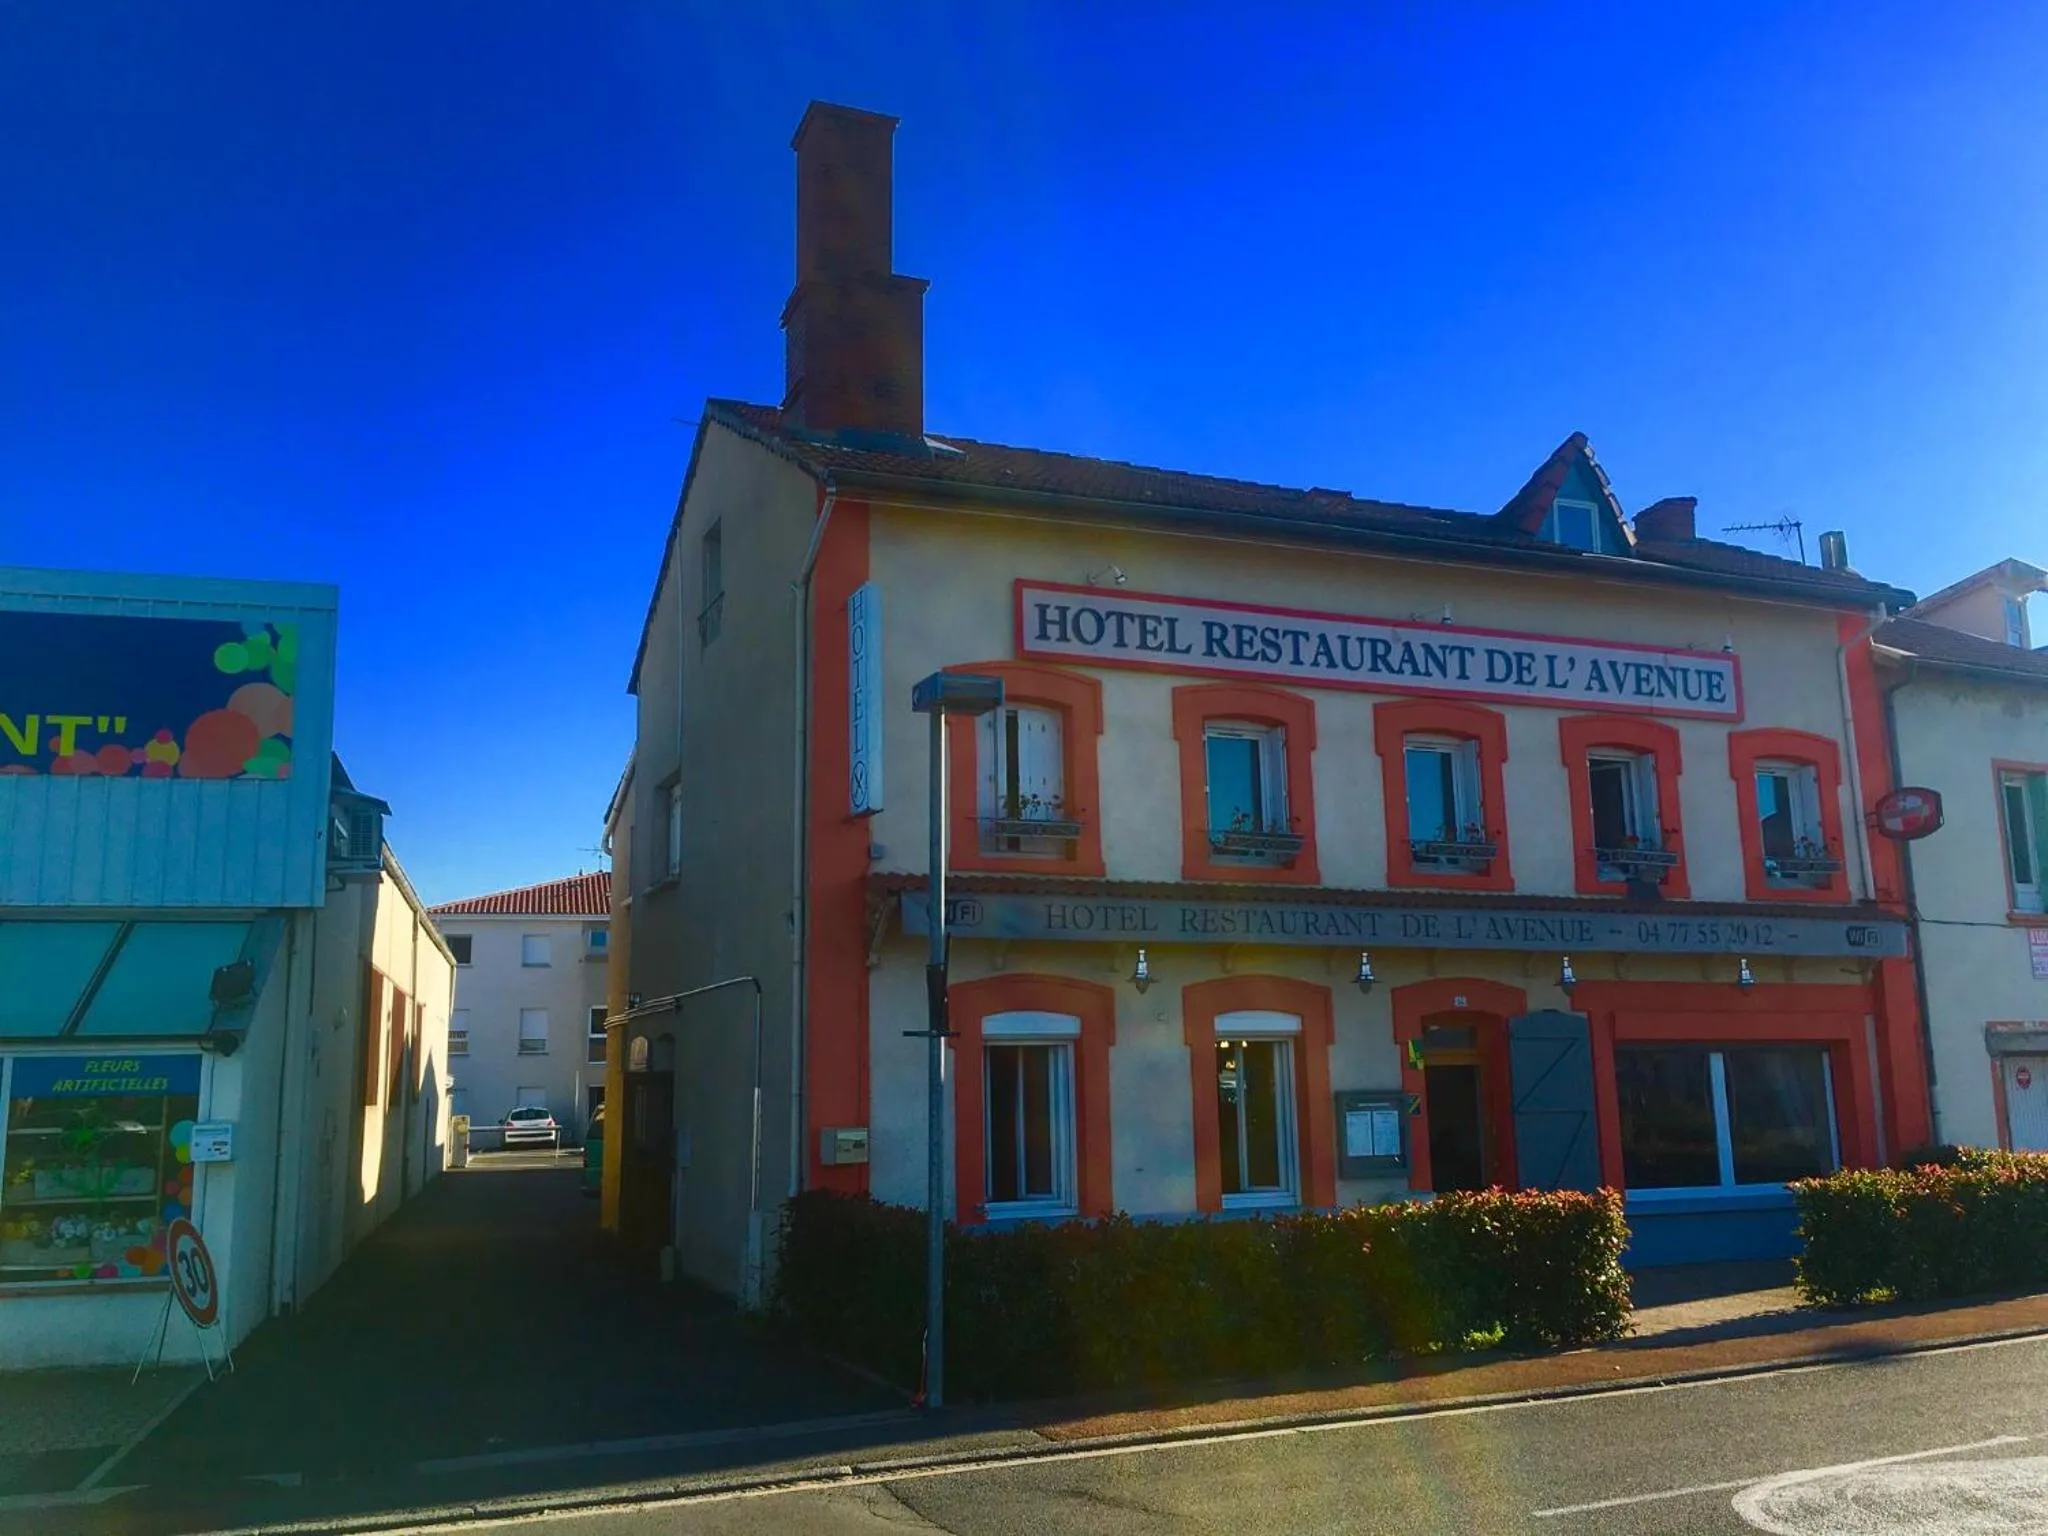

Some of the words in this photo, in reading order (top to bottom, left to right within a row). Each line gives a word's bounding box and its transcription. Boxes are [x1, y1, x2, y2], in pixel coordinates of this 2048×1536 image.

[1034, 603, 1193, 654] HOTEL
[1201, 620, 1475, 681] RESTAURANT
[1484, 648, 1538, 686] DE
[852, 590, 865, 755] HOTEL
[1045, 903, 1158, 932] HOTEL
[1178, 907, 1383, 937] RESTAURANT
[1400, 913, 1441, 939] DE
[1637, 921, 1661, 945] 04
[1668, 922, 1689, 944] 77
[1697, 922, 1720, 944] 55
[52, 1077, 169, 1093] ARTIFICIELLES
[84, 1059, 142, 1073] FLEURS
[178, 1247, 209, 1297] 30
